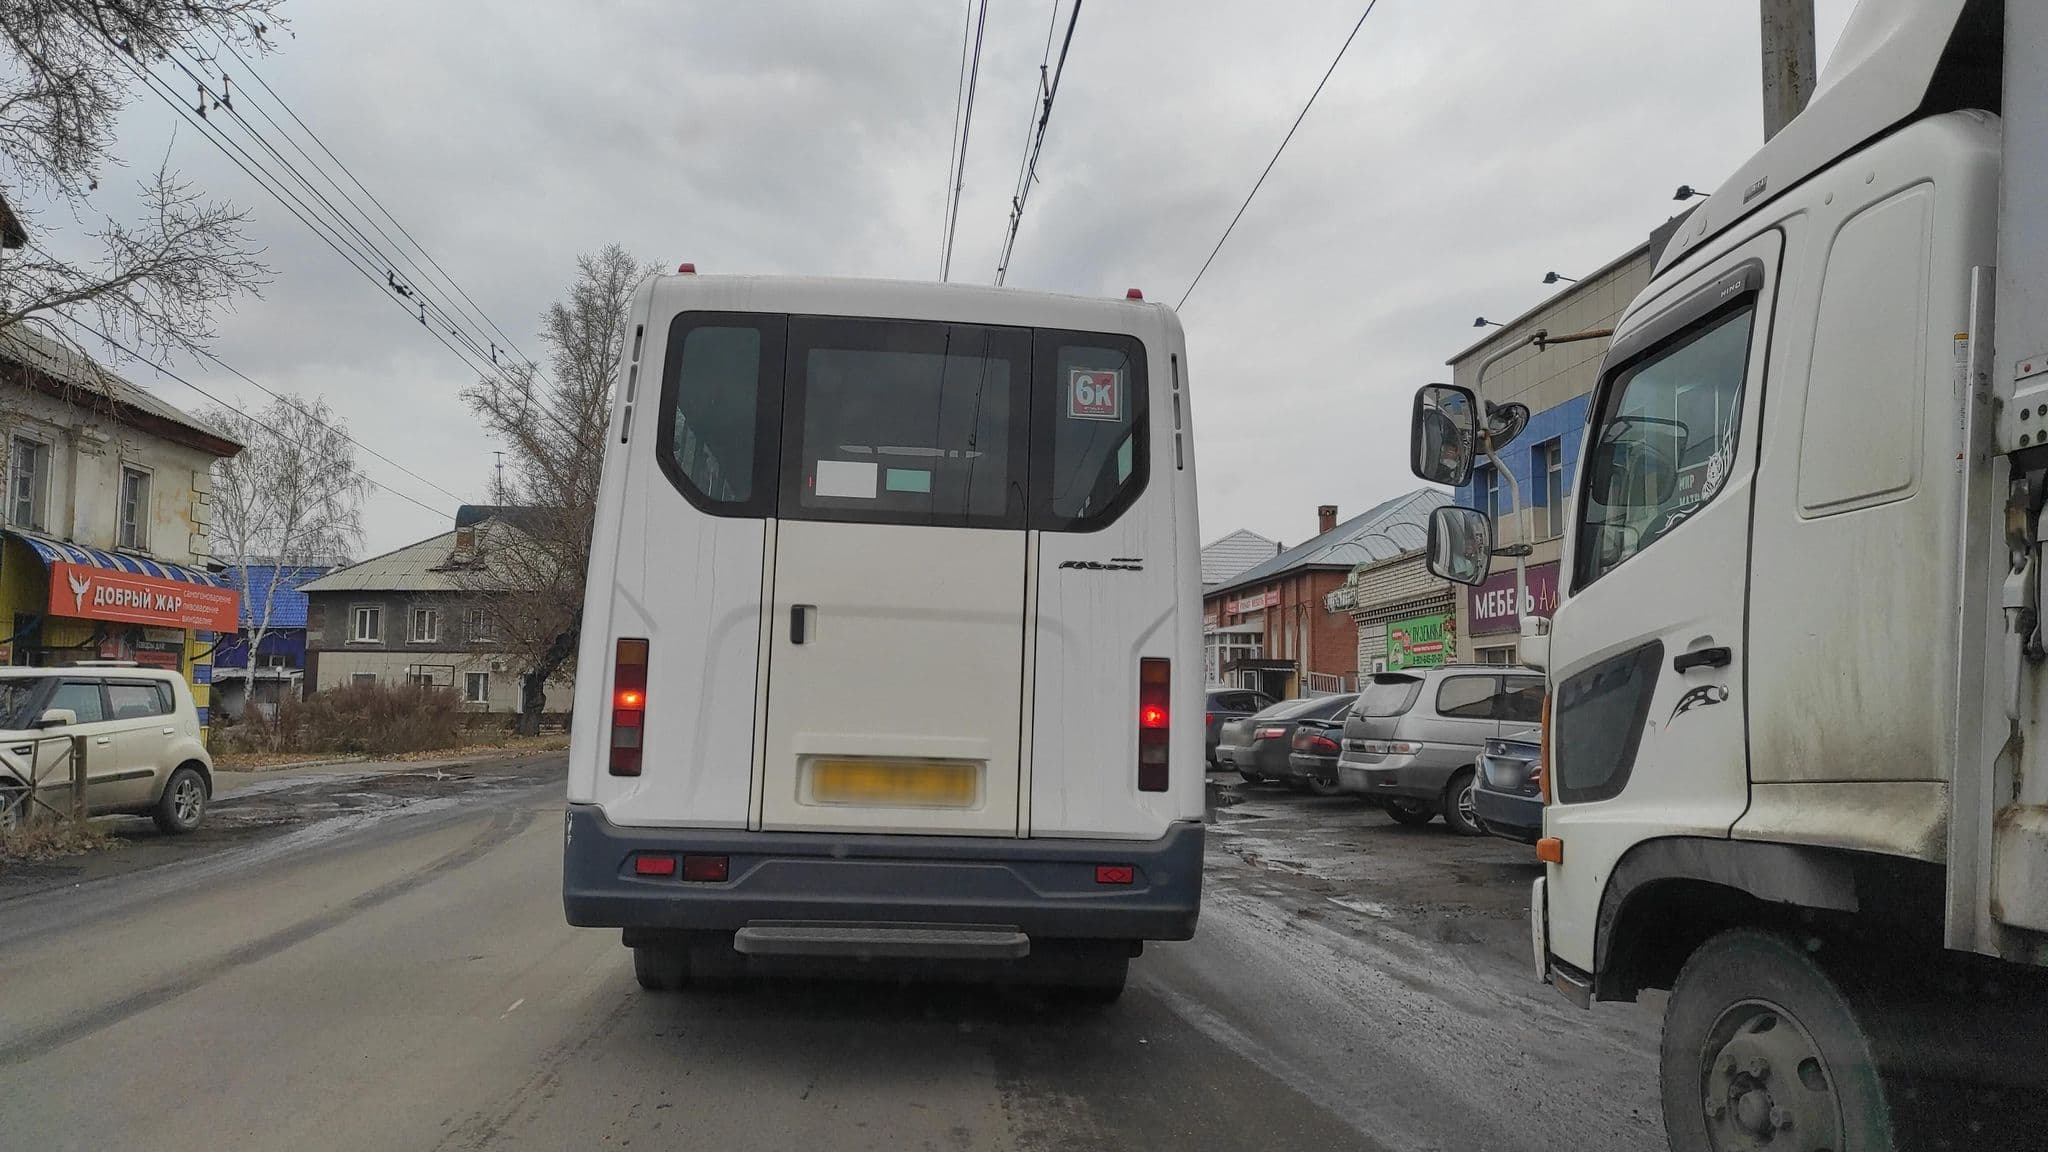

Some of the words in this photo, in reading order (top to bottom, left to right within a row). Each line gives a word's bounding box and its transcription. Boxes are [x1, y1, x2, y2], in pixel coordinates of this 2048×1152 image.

[1720, 280, 1741, 298] HINO
[93, 585, 151, 608] ДОБРЫЙ
[154, 594, 182, 612] ЖАР
[1475, 585, 1535, 620] МЕБЕЬ
